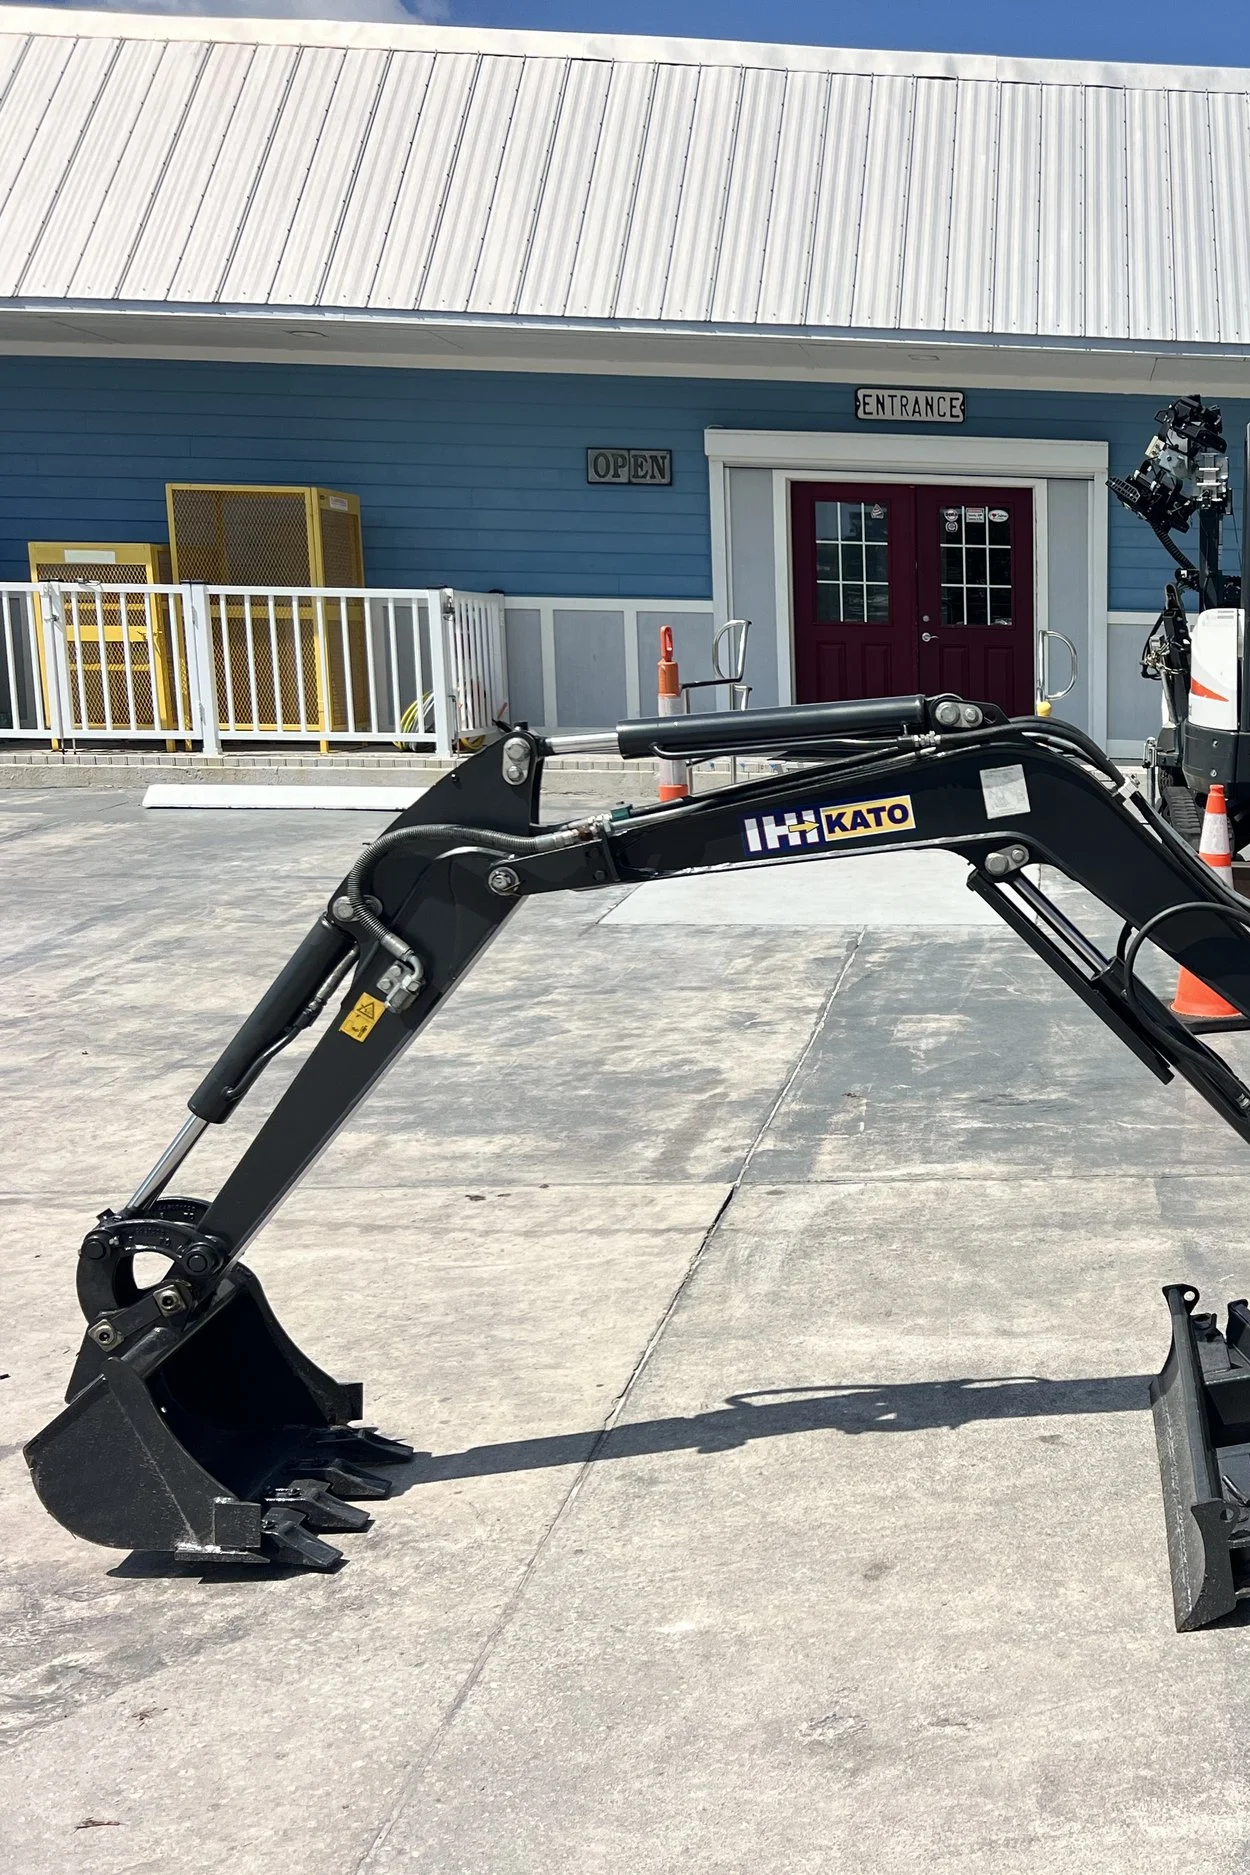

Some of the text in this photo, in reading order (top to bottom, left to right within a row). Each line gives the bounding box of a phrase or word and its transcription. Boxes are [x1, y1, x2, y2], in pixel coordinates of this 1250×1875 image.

[862, 394, 962, 418] ENTRANCE
[593, 453, 668, 480] OPEN
[824, 803, 910, 835] KATO
